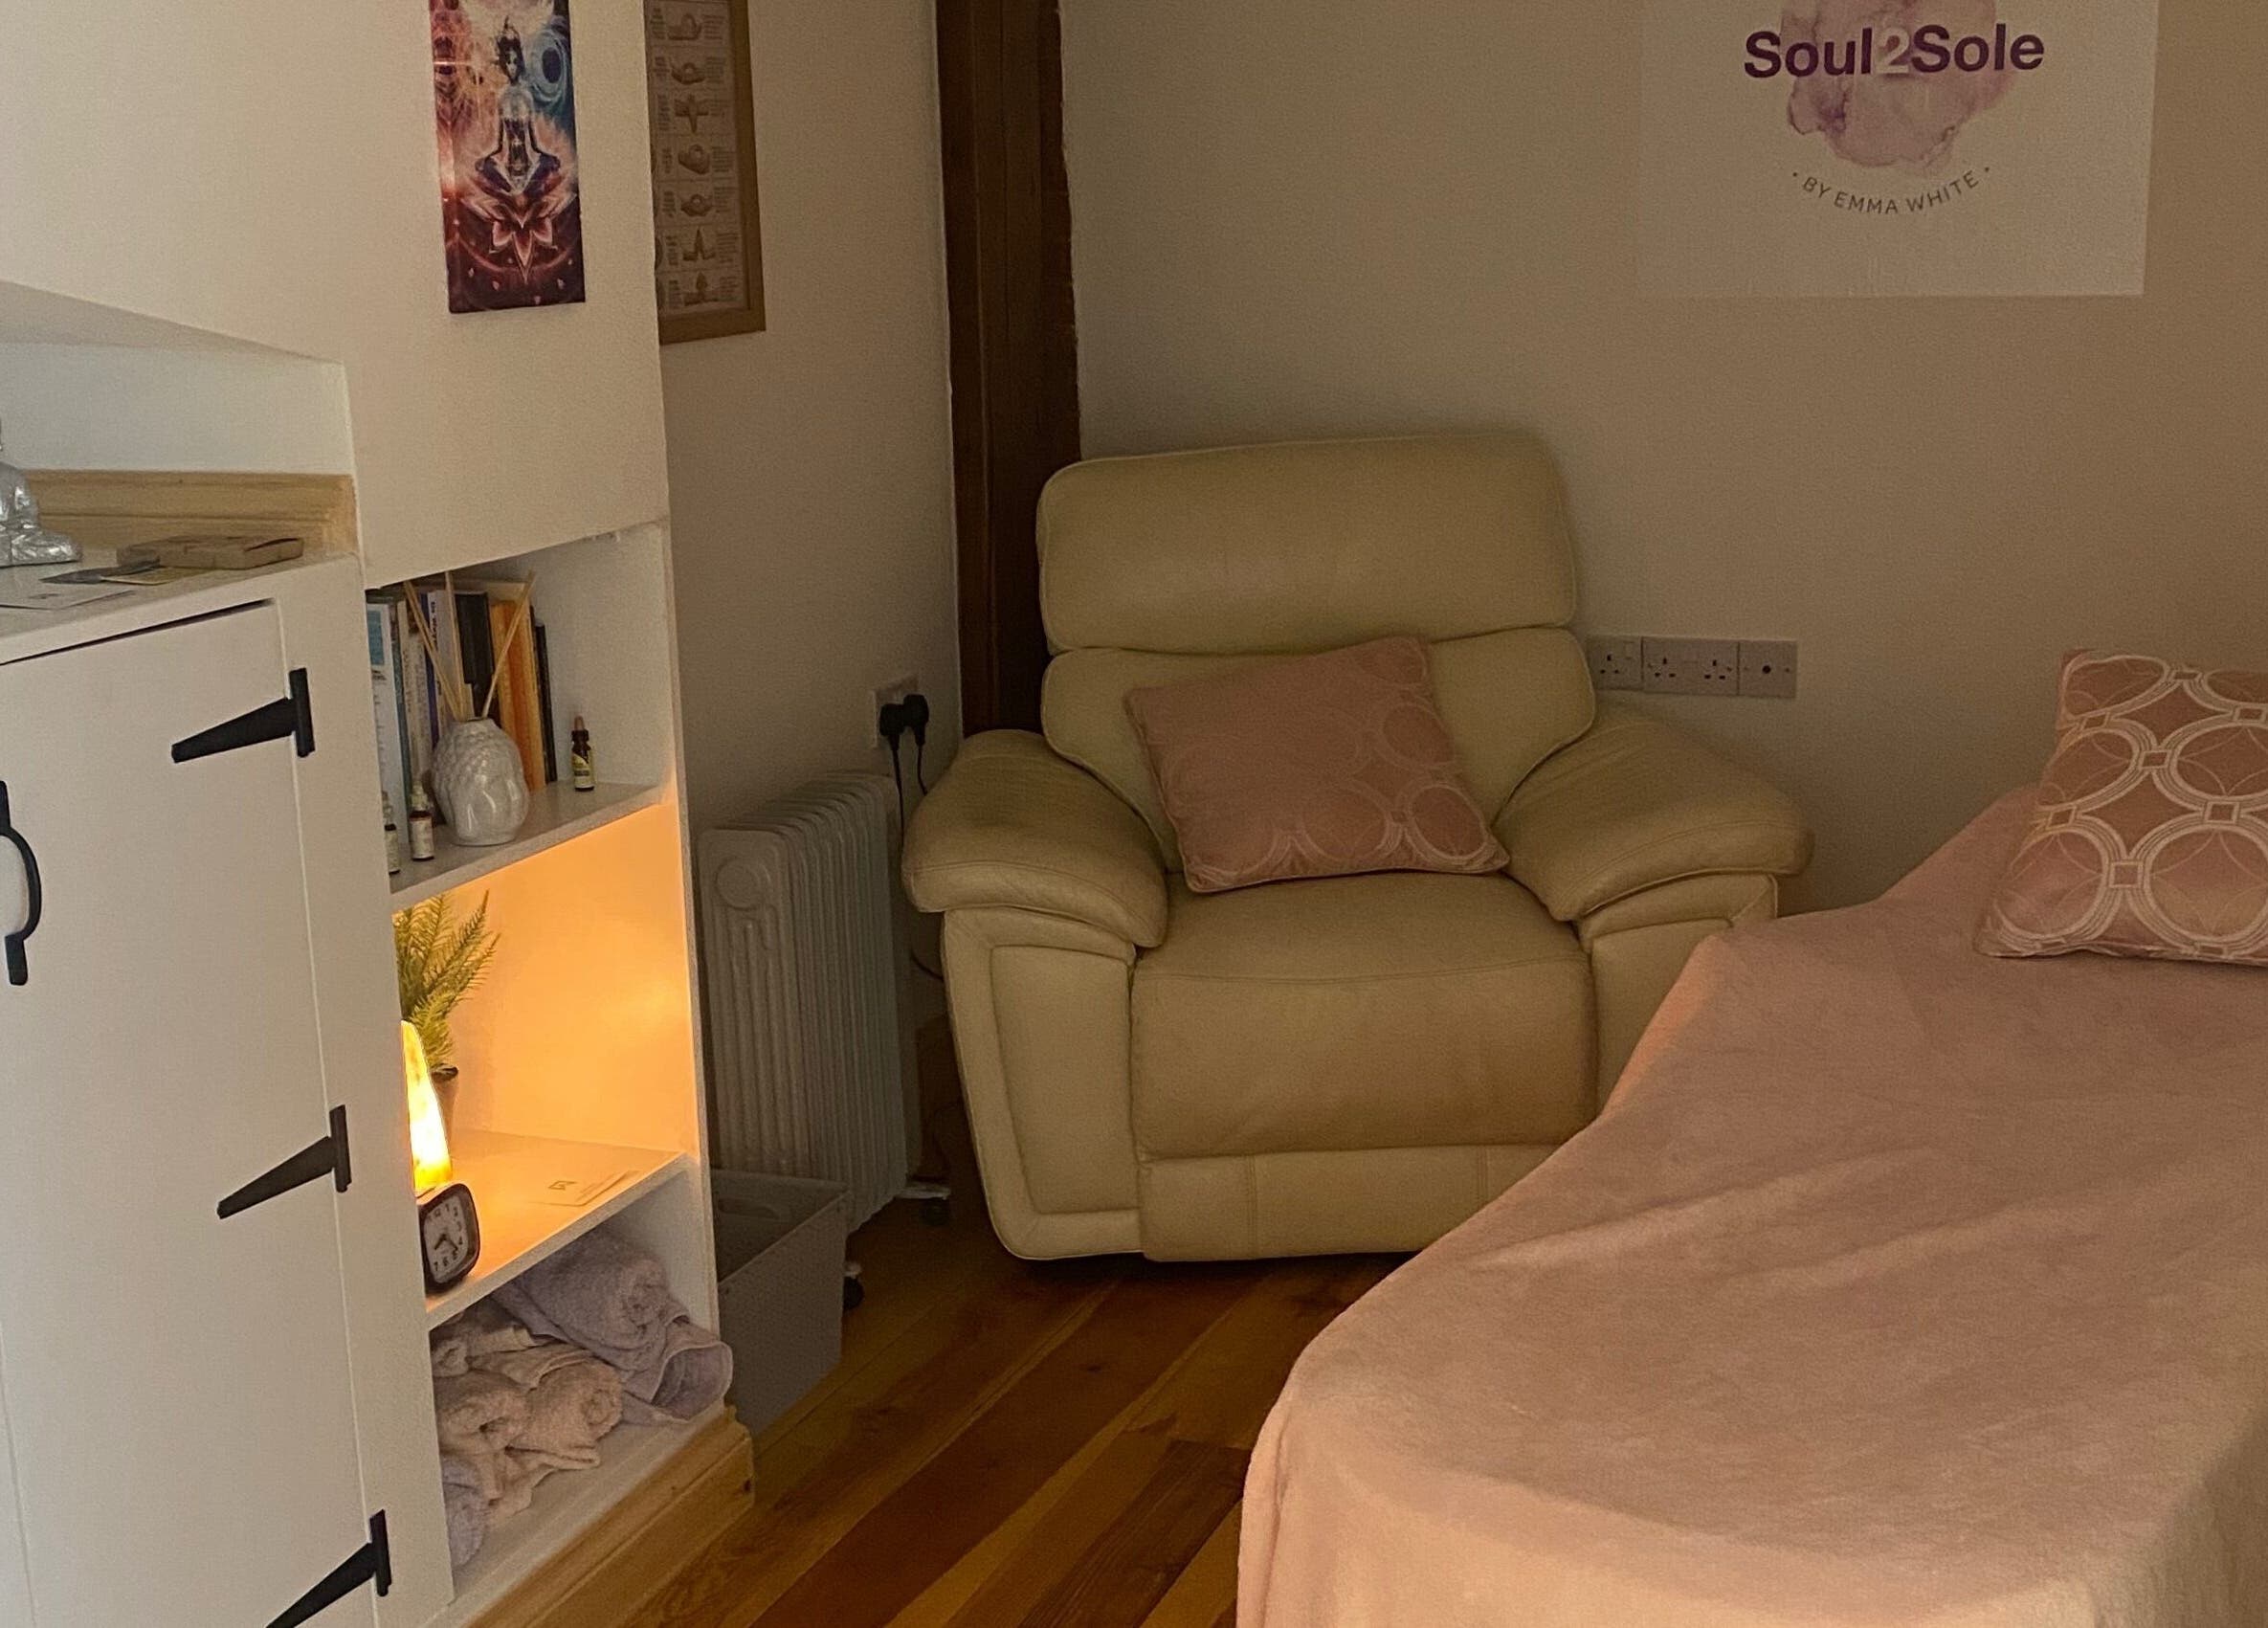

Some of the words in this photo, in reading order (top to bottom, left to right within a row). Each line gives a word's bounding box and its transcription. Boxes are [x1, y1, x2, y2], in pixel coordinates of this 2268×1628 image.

[1745, 23, 2045, 78] Soul2Sole
[1802, 176, 1832, 198] BY
[1834, 191, 1899, 214] EMMA
[1905, 169, 1980, 212] WHITE
